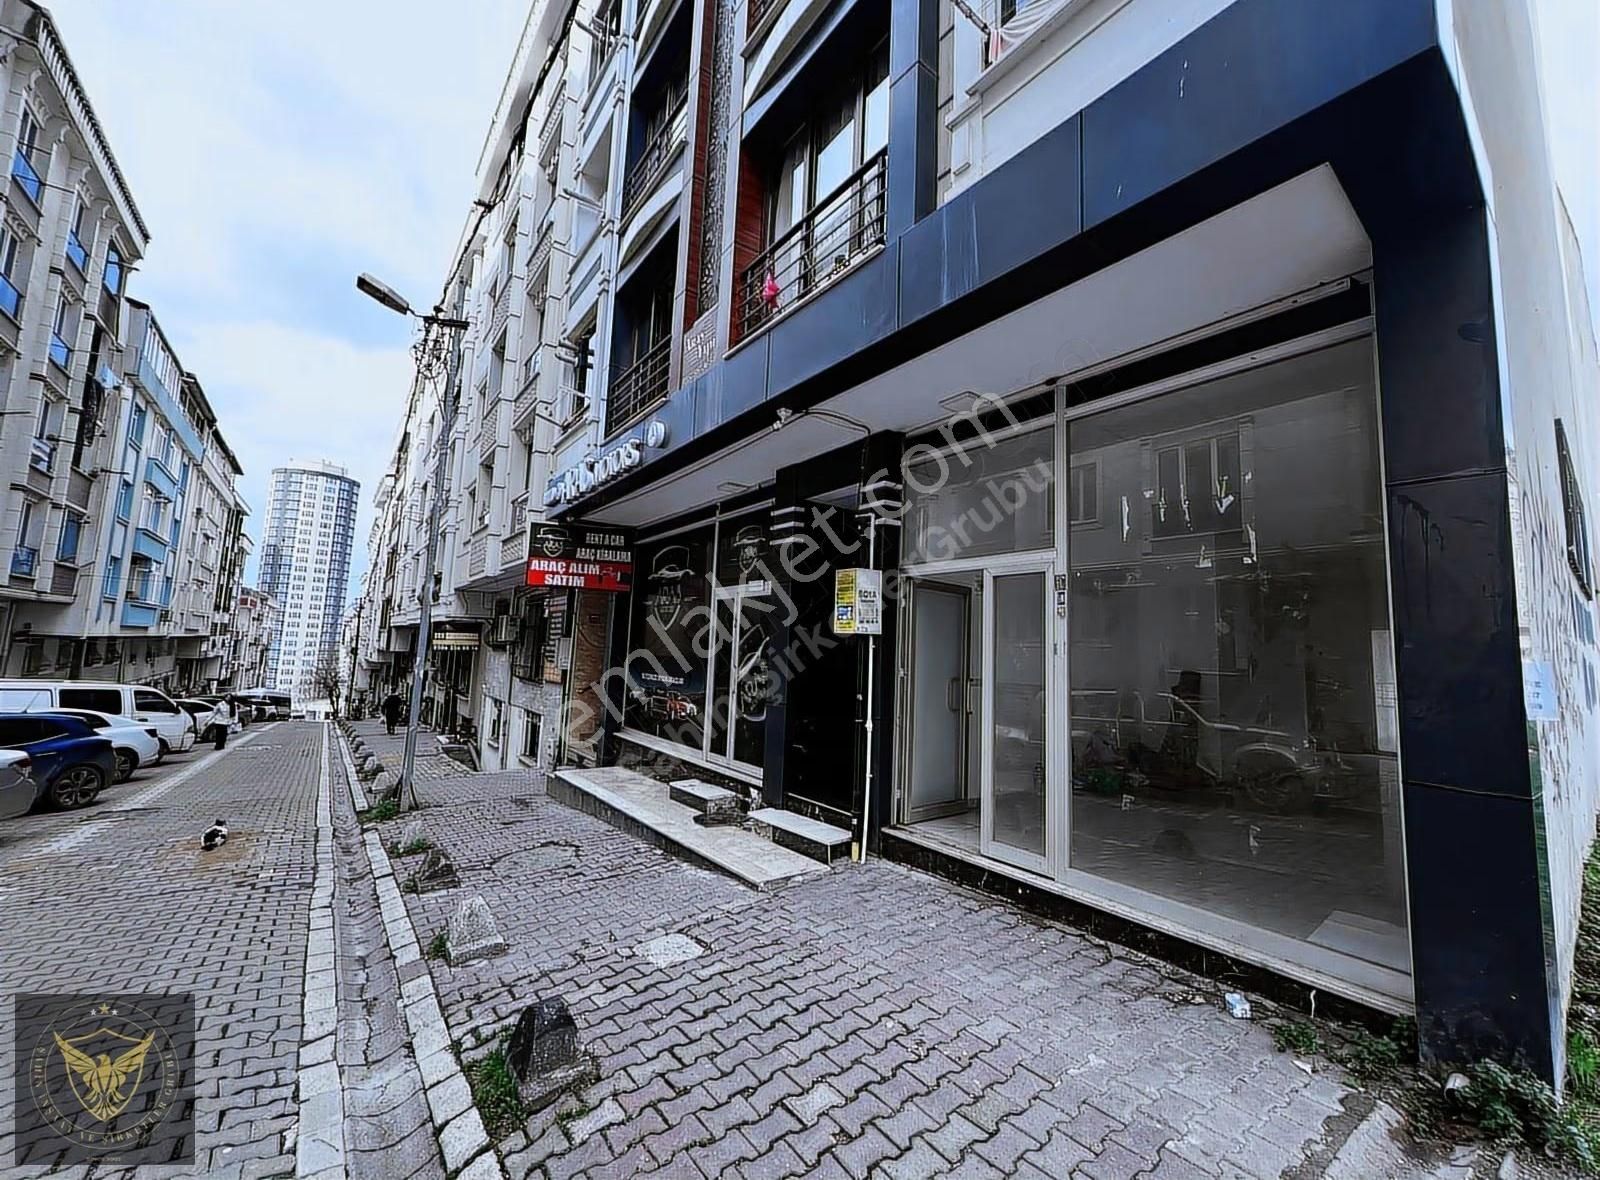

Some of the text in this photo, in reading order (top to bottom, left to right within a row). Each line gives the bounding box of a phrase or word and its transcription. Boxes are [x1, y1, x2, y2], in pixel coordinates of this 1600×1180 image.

[531, 559, 601, 575] ARAÇ ALIM
[544, 573, 585, 587] SATIM
